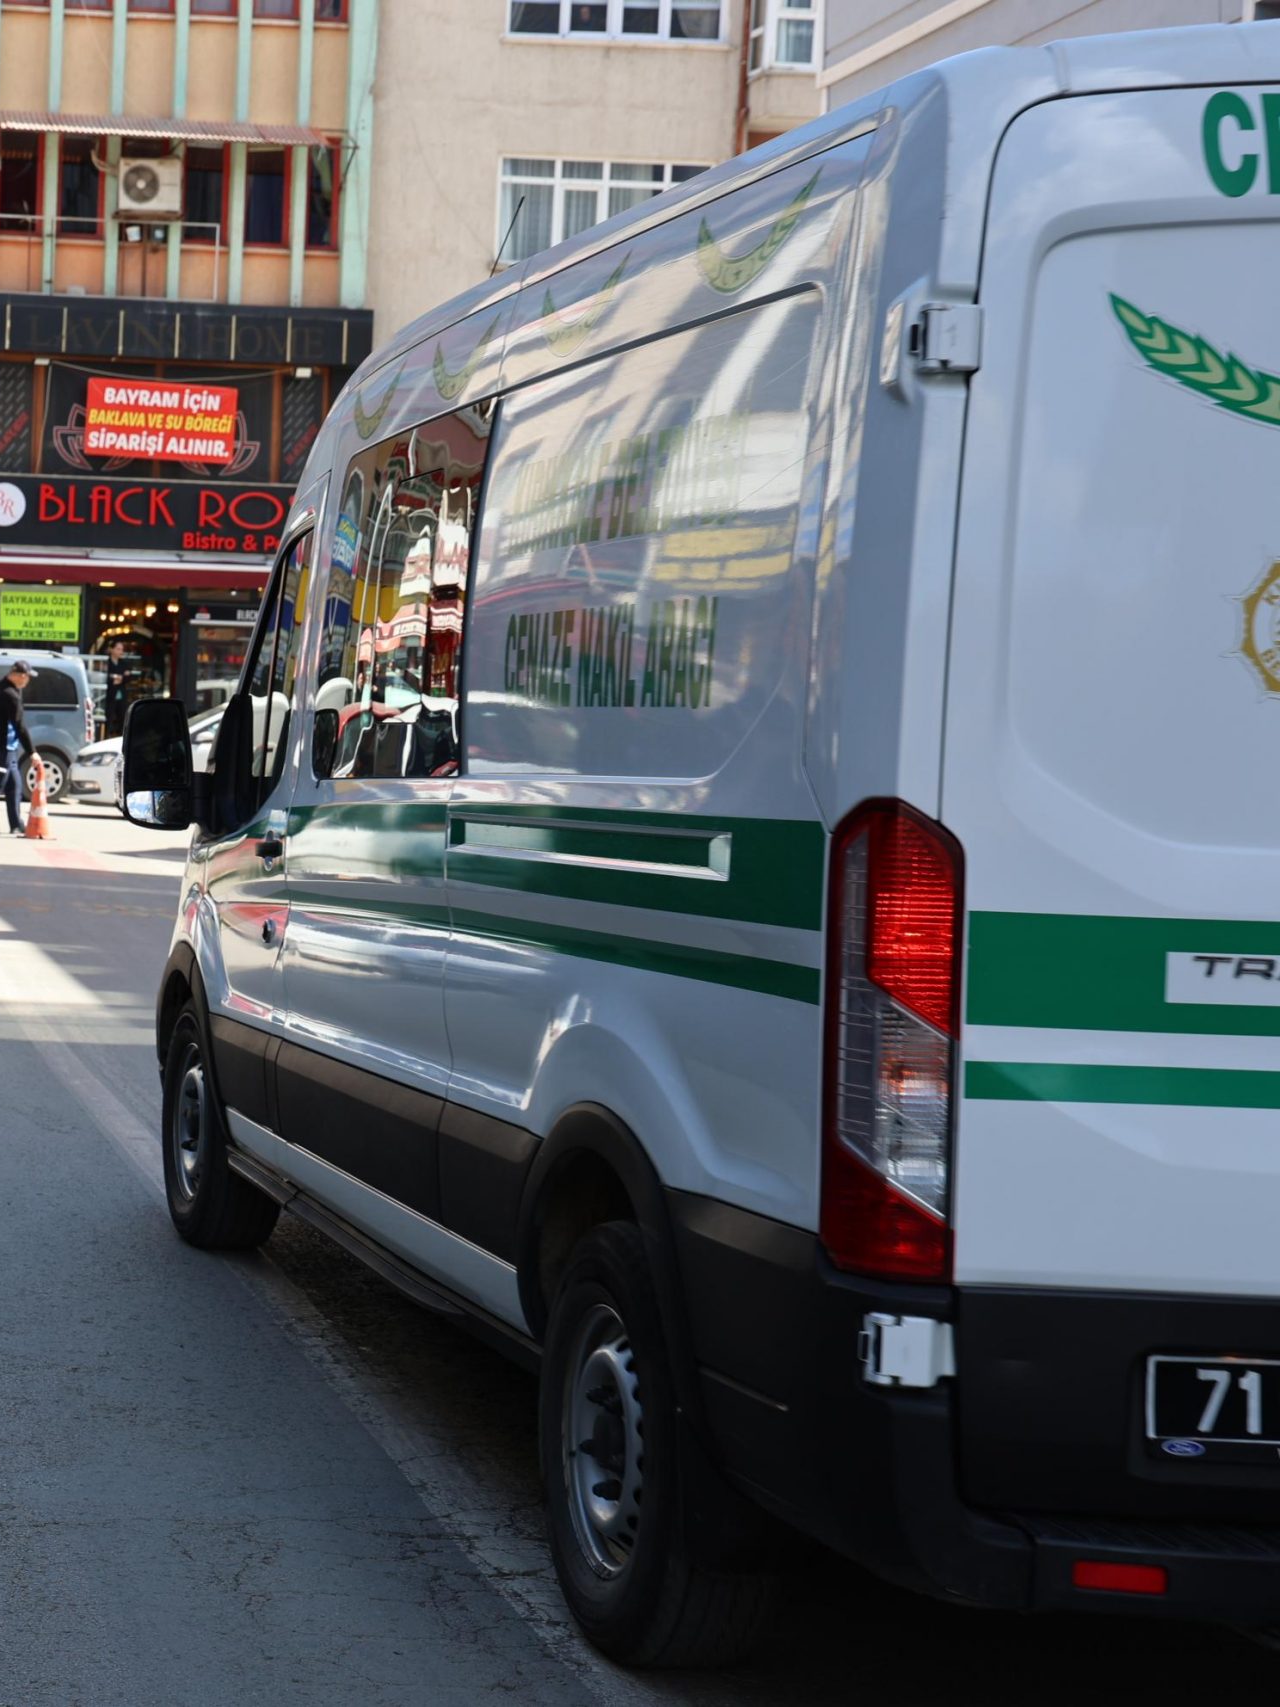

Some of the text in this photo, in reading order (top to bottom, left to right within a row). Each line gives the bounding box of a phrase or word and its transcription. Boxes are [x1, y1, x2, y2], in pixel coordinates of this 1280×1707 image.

[104, 387, 220, 413] BAYRAM İÇİN
[88, 408, 234, 433] BAKLAVA VE SU BÖREĞİ
[88, 427, 229, 457] SİPARİŞİ ALINIR.
[38, 483, 295, 530] BLACK RO
[183, 532, 236, 550] Bistro
[243, 534, 258, 551] &
[504, 595, 719, 709] CENAZE NAKİL ARACI
[1192, 955, 1280, 981] TR
[1196, 1368, 1262, 1435] 71
